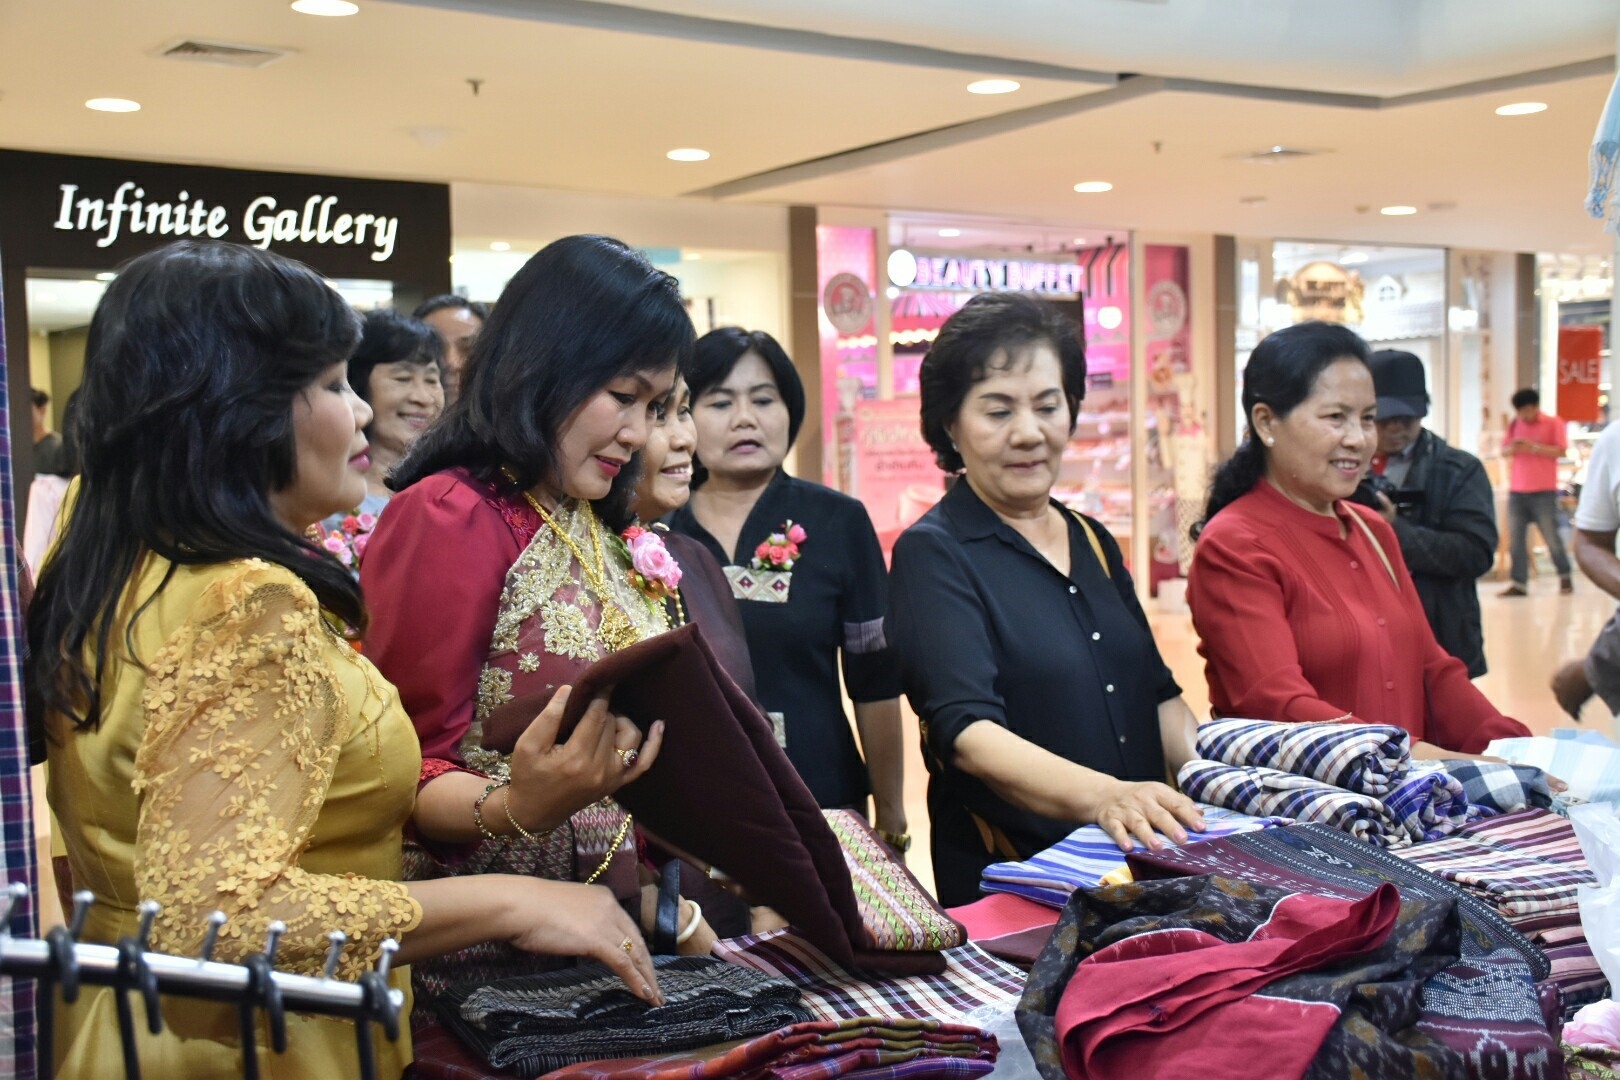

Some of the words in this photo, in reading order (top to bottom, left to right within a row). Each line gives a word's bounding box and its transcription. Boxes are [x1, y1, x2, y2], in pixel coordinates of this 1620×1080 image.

[54, 182, 229, 247] Infinite
[242, 195, 399, 262] Gallery
[915, 256, 1004, 290] BEAUTY
[1006, 261, 1084, 293] BUFFET
[1559, 358, 1600, 385] SALE
